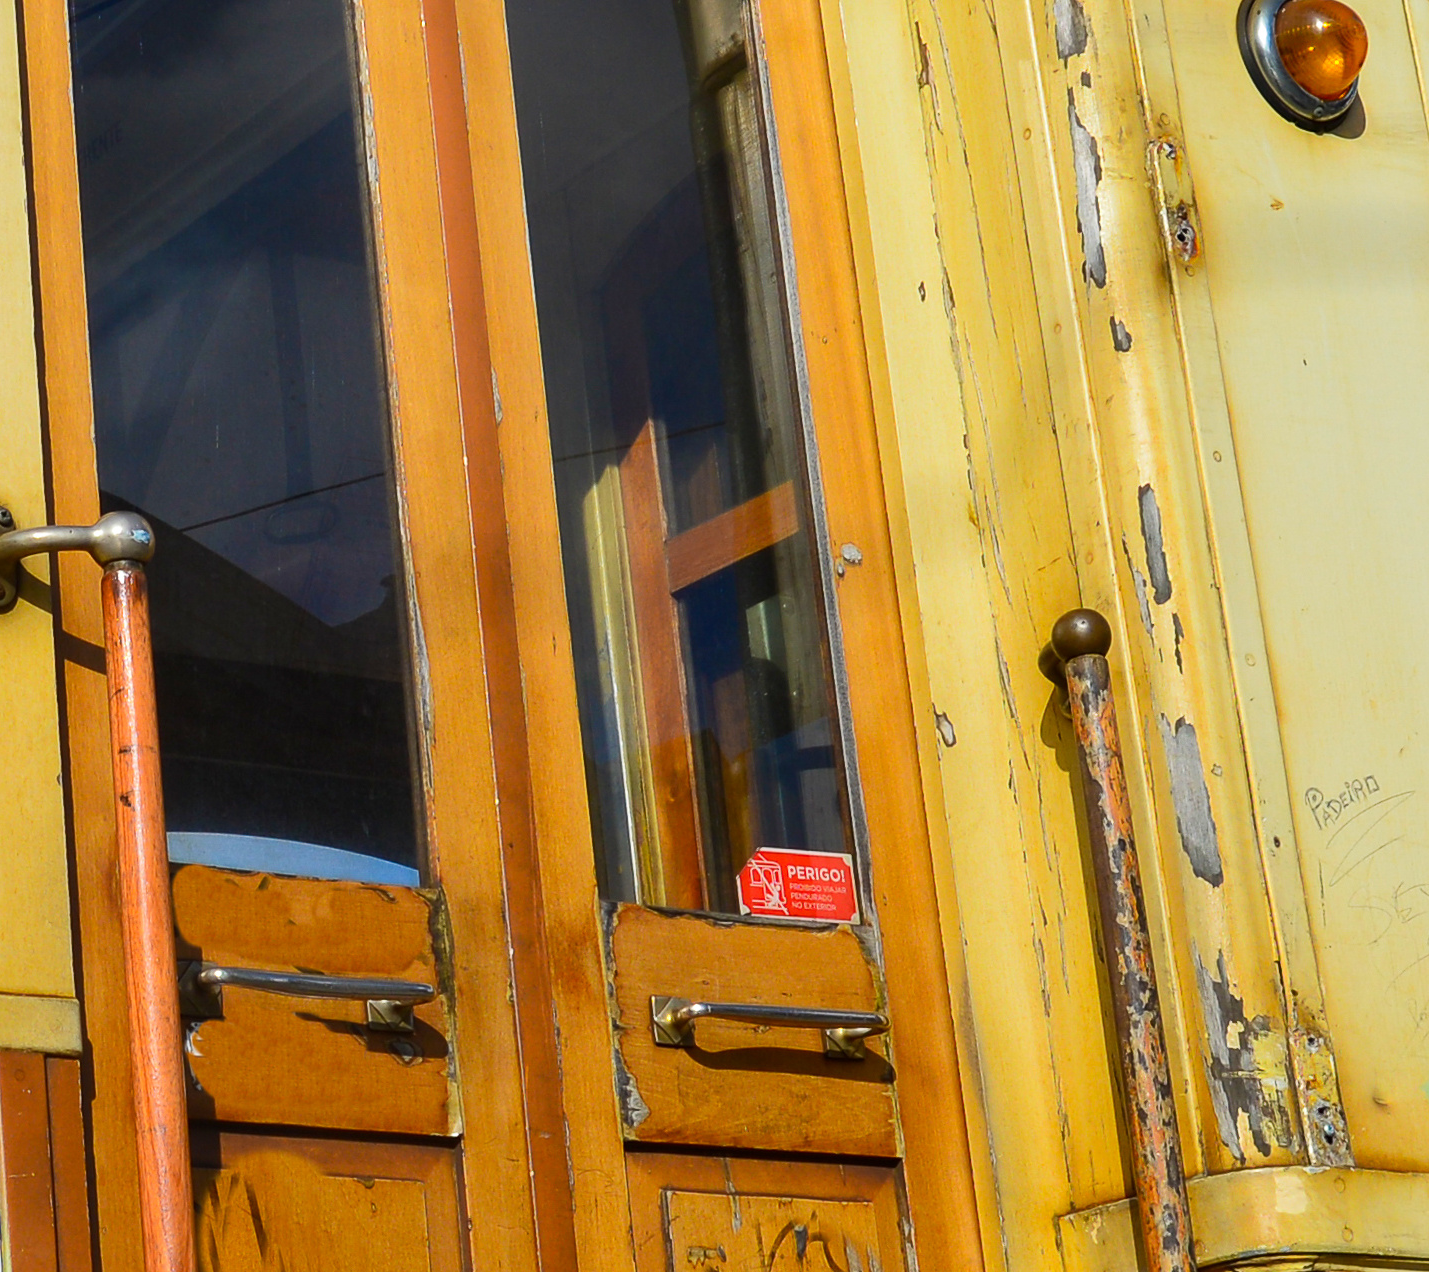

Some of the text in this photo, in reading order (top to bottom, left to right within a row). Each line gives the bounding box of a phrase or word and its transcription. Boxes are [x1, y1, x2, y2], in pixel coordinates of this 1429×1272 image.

[787, 865, 846, 883] PERIGO!
[789, 882, 847, 894] PROIBIDO VIAJAR
[790, 892, 833, 902] PENDURADO
[791, 901, 837, 911] NO EXTERIOR
